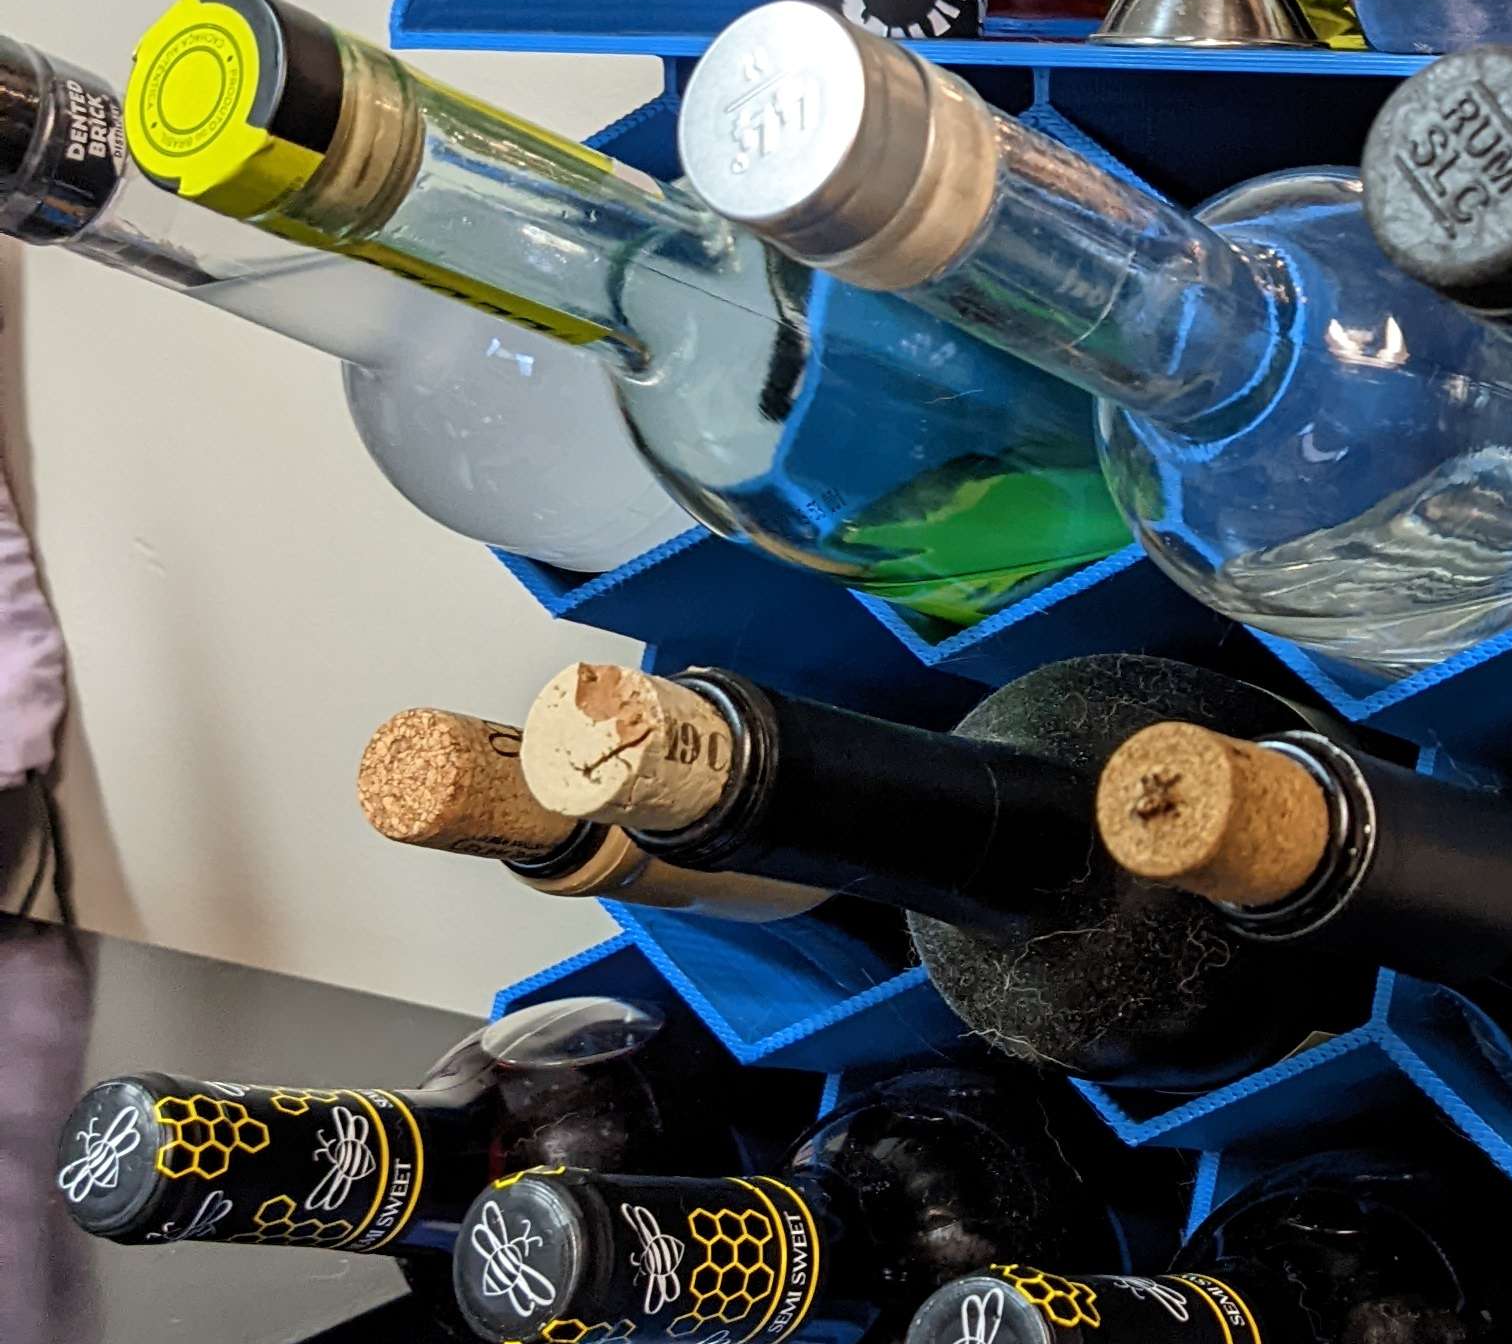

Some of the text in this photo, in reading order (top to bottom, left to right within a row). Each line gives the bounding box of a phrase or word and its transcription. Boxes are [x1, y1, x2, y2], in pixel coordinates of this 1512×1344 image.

[65, 79, 88, 161] DENTED
[87, 93, 107, 158] BRICK
[1410, 124, 1490, 223] SLC
[376, 1158, 412, 1227] SWEET
[767, 1211, 808, 1334] SEMI SWEET
